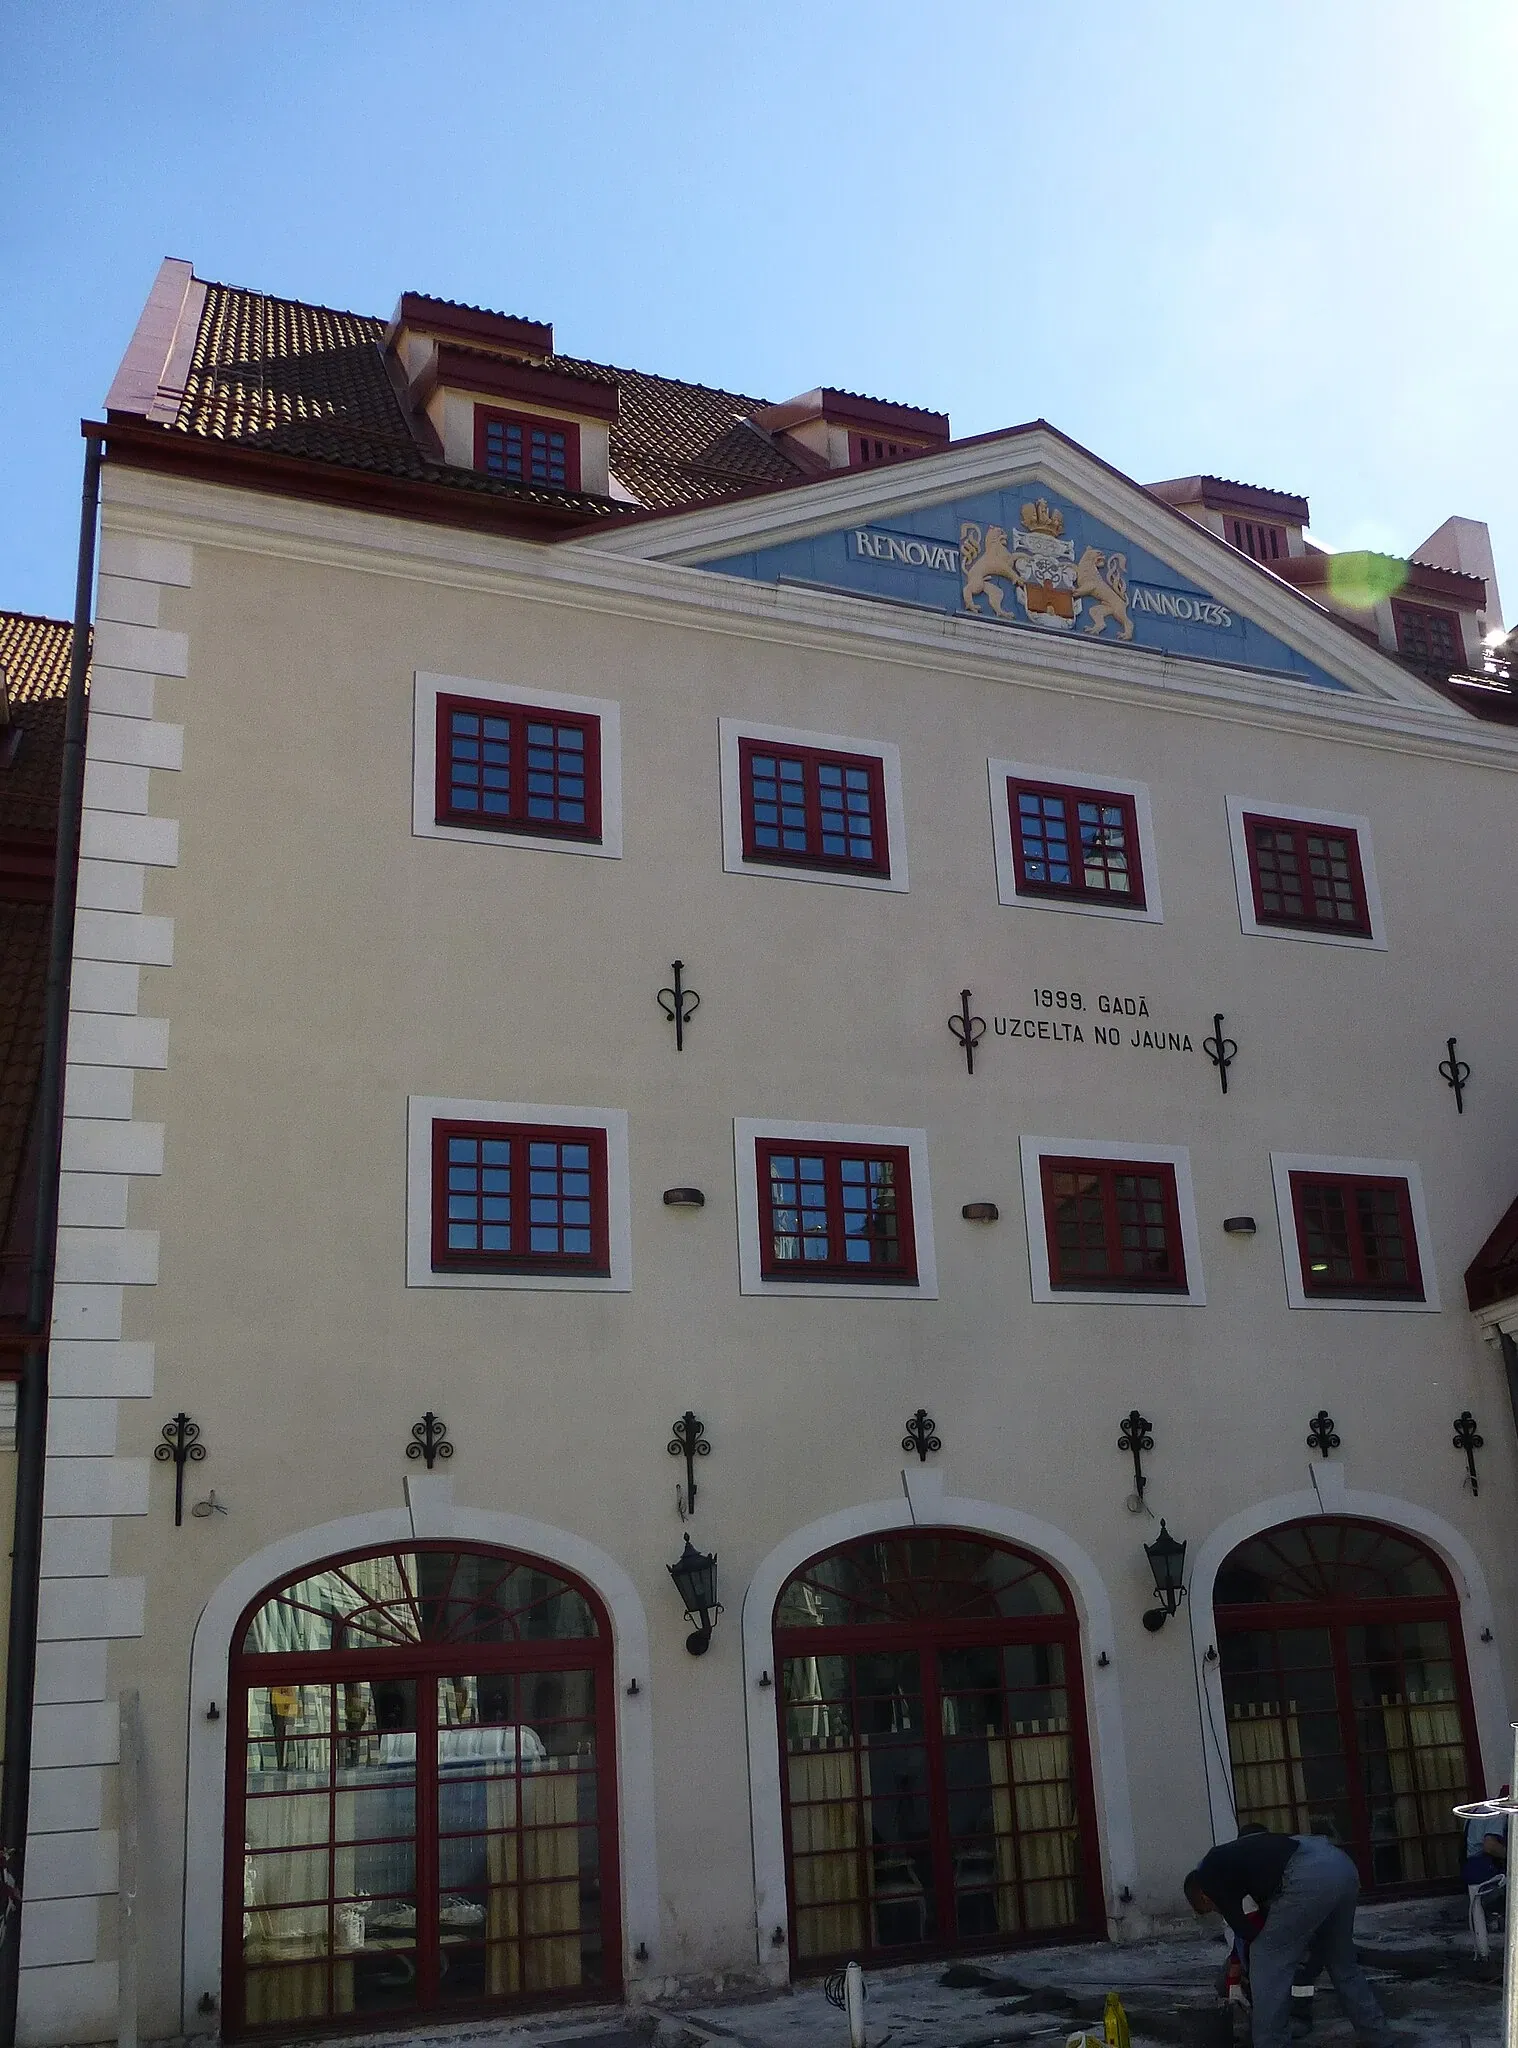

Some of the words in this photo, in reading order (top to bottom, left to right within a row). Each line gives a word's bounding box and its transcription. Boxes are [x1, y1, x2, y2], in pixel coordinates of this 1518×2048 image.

[855, 531, 959, 573] RENOVAT
[1131, 588, 1192, 619] ANNO
[1034, 989, 1087, 1011] 1999.
[1099, 996, 1150, 1018] GADĀ
[994, 1017, 1084, 1043] UZCELTA
[1095, 1026, 1120, 1045] NO
[1131, 1029, 1193, 1052] JAUNA
